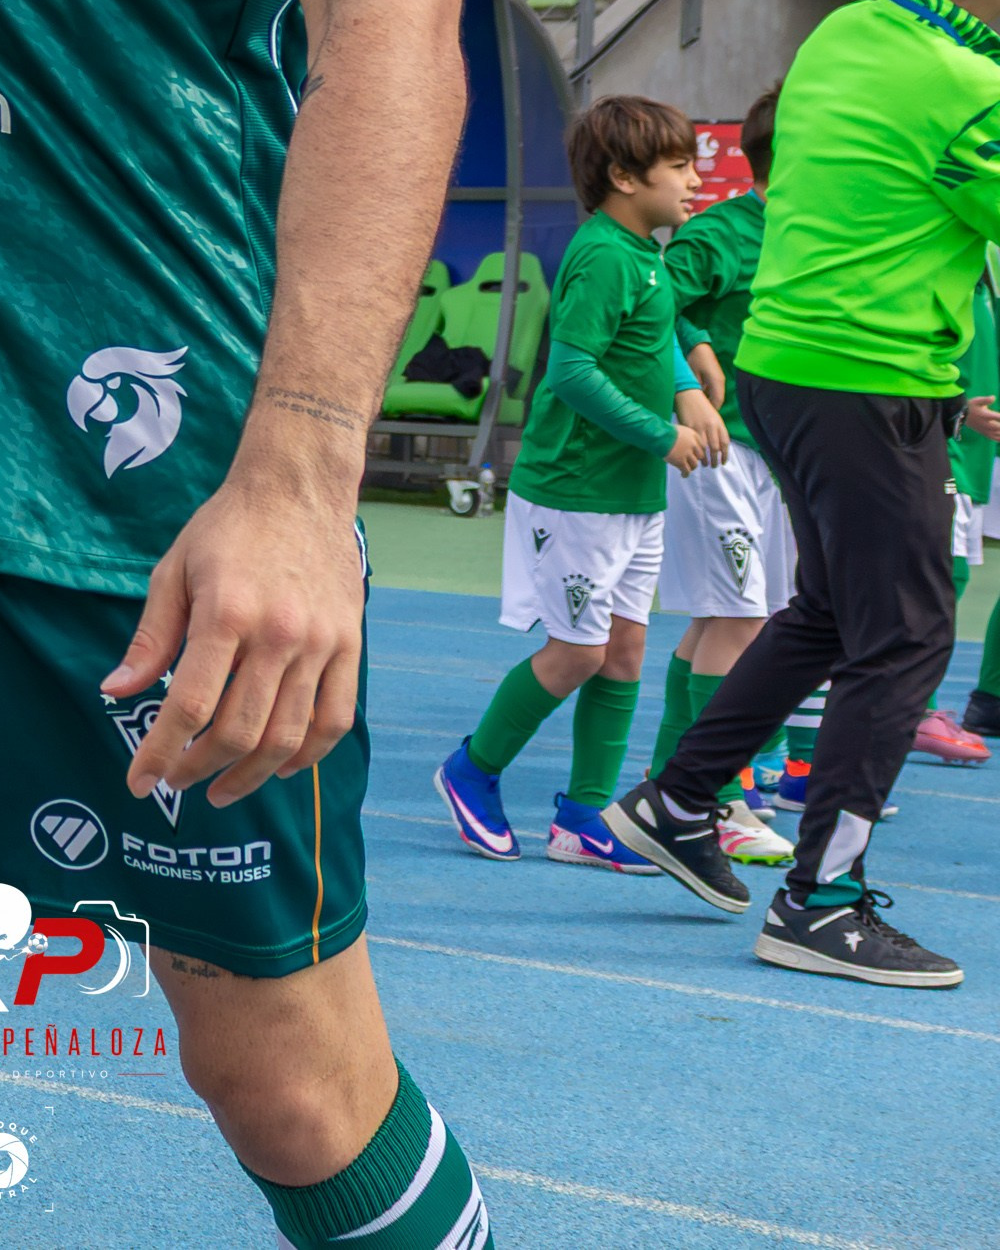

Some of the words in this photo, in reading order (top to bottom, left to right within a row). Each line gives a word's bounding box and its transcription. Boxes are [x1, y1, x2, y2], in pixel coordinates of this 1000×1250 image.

[123, 854, 203, 882] CAMIONES
[203, 870, 217, 882] Y
[220, 864, 272, 883] BUSES
